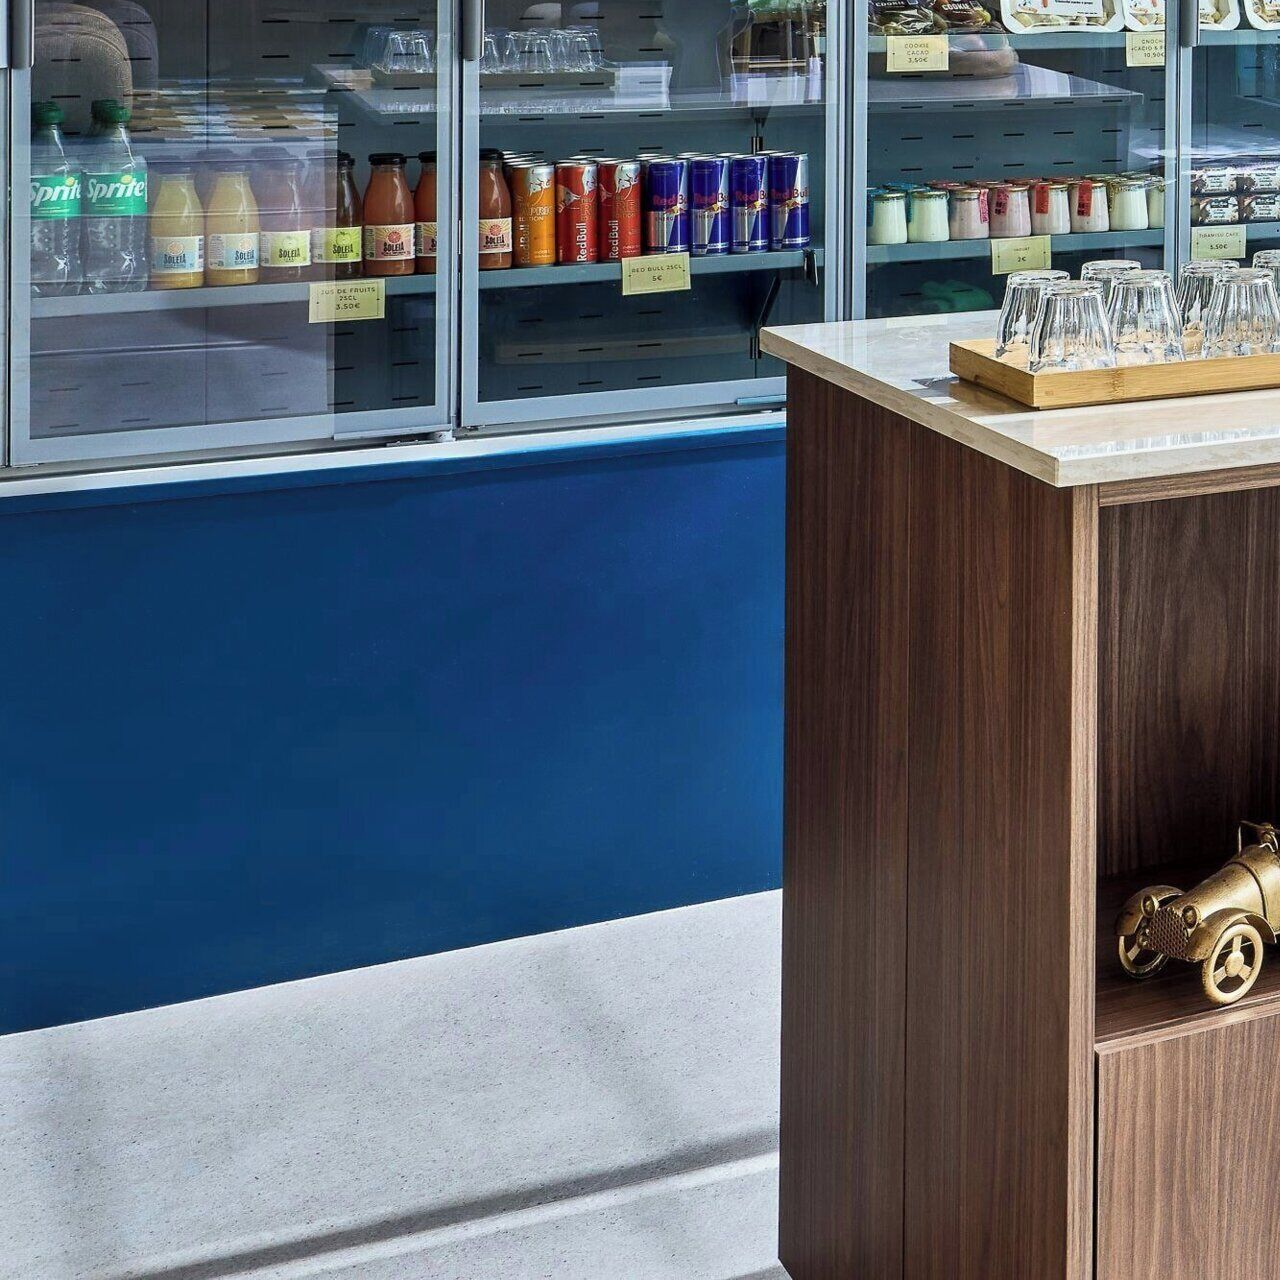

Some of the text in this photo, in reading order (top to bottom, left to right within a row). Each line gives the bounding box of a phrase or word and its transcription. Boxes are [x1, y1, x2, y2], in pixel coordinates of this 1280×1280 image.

[87, 176, 145, 201] Sprite
[607, 220, 619, 239] Bull
[576, 242, 588, 262] Red
[336, 286, 348, 295] DE
[349, 286, 376, 294] FRUITS
